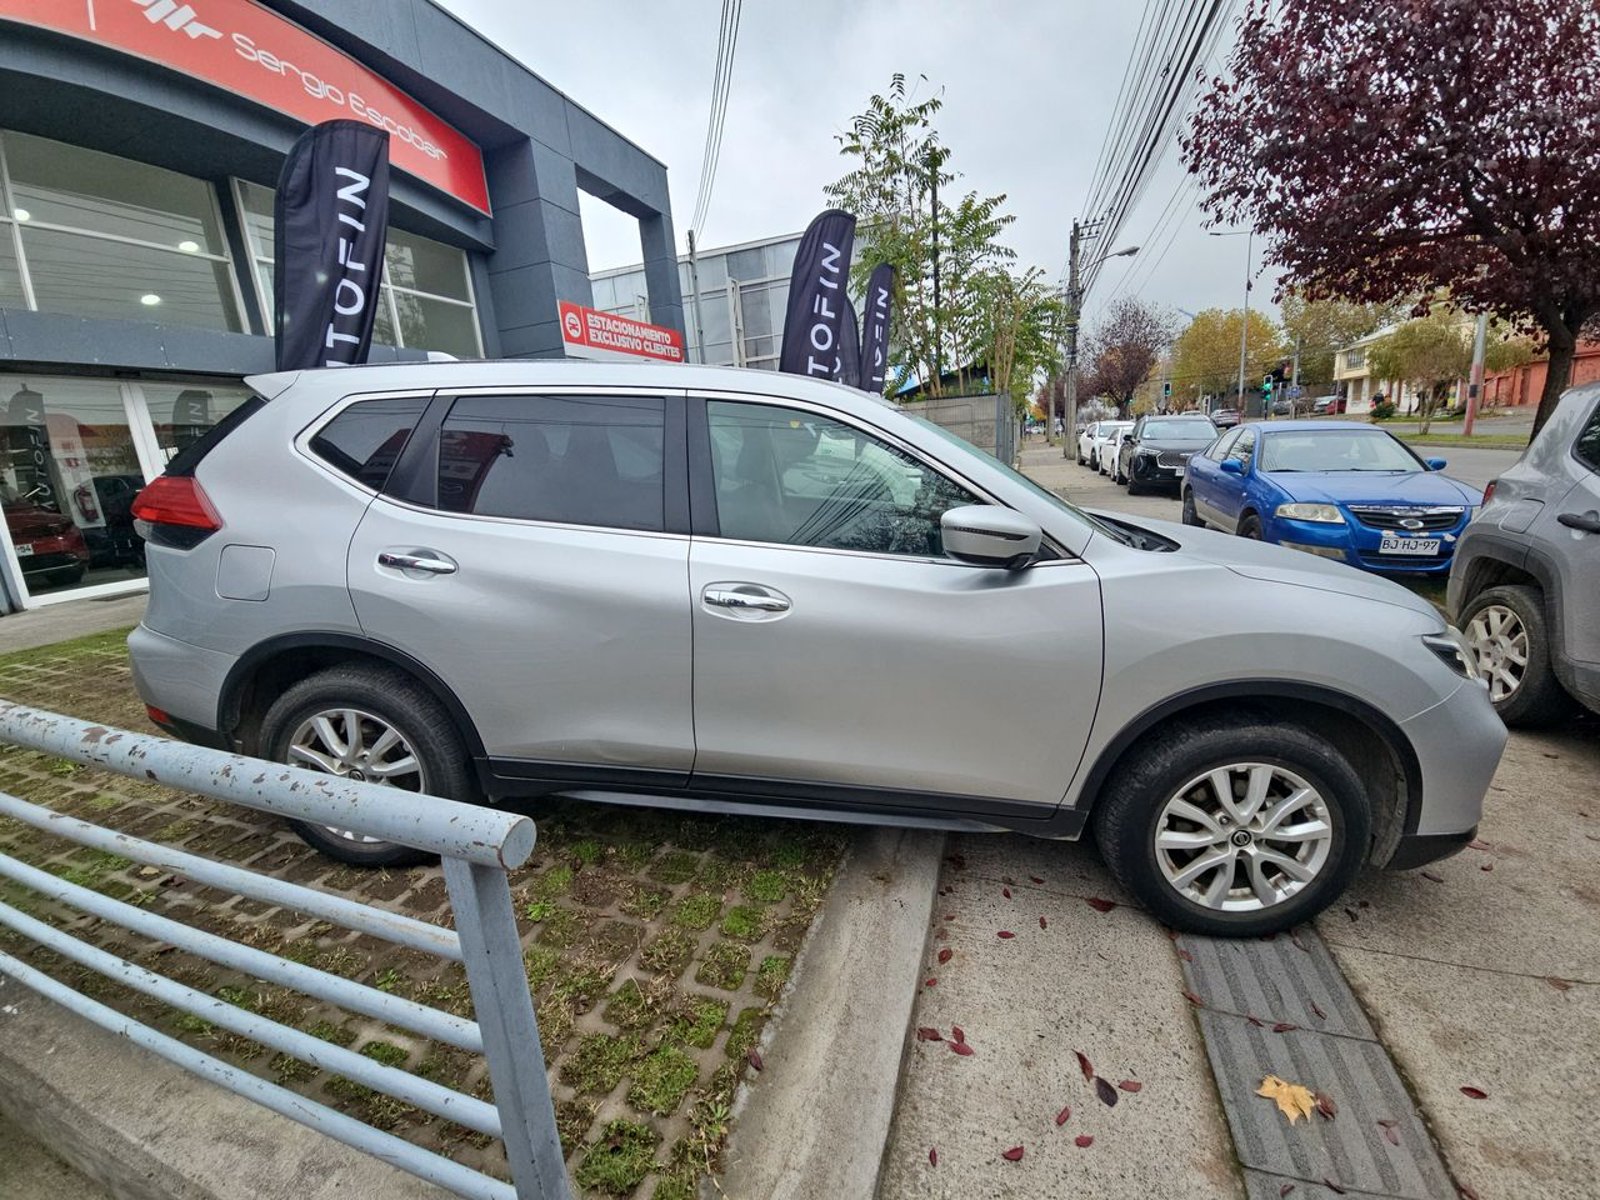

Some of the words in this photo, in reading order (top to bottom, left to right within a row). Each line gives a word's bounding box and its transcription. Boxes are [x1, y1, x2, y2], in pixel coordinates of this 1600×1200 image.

[231, 33, 345, 105] Sergio
[348, 92, 448, 160] Escobar
[326, 167, 370, 367] TOFIN
[586, 313, 671, 345] ESTACIONAMIENTO
[589, 328, 642, 351] EXCLUSIVO
[643, 341, 681, 358] CLIENTES
